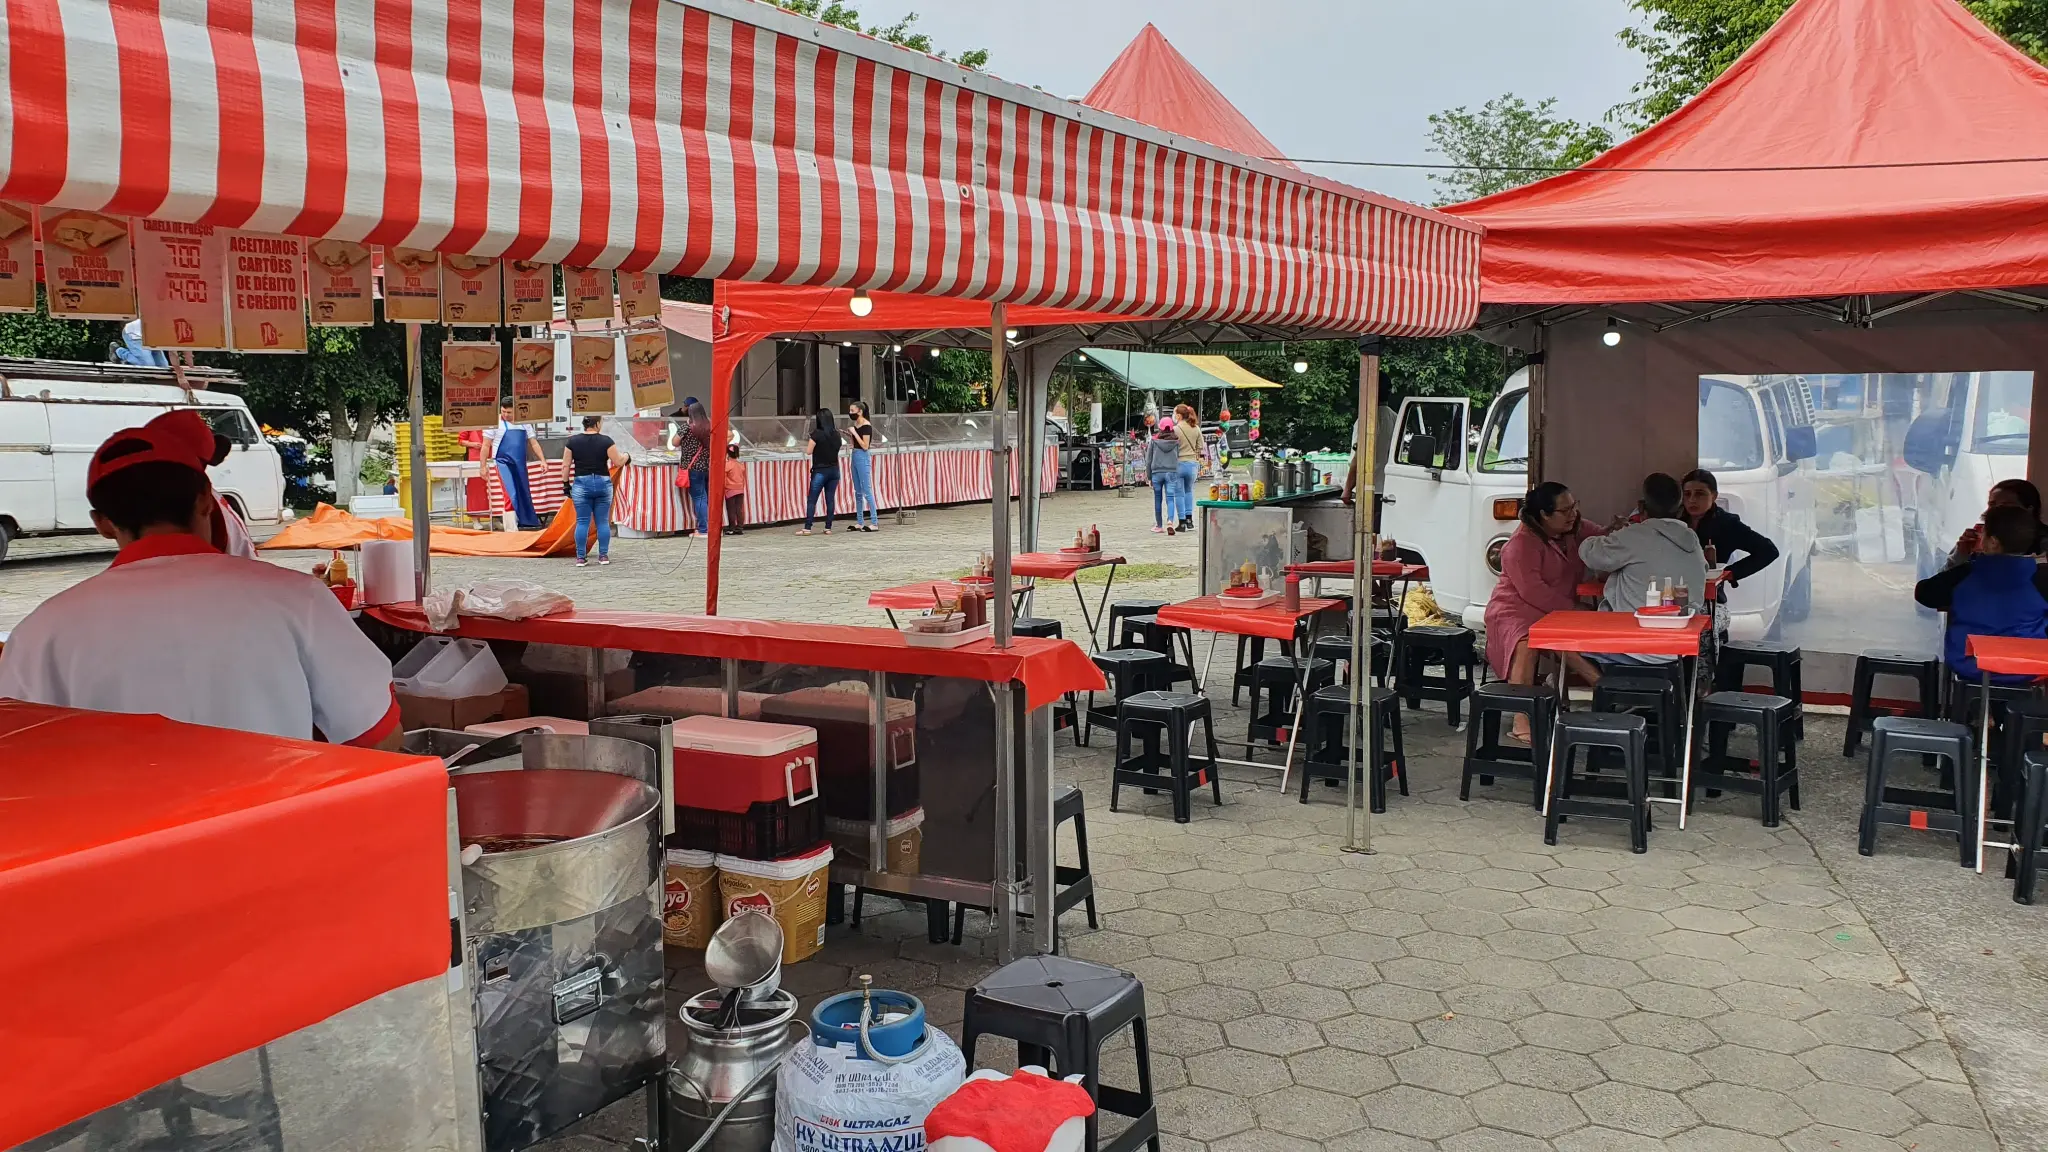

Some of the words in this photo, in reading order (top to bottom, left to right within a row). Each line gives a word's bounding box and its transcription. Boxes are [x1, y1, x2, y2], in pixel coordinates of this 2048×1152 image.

[230, 236, 298, 255] ACEITAMOS
[72, 255, 108, 268] FRANGO
[238, 255, 292, 274] CARTÕES
[58, 267, 80, 281] COM
[236, 275, 252, 290] DE
[253, 274, 296, 292] DÉBITO
[236, 294, 245, 309] E
[246, 293, 297, 311] CRÉDITO
[835, 1073, 846, 1083] HY
[819, 1114, 841, 1128] DISK
[843, 1114, 911, 1129] ULTRAGAZ
[796, 1122, 816, 1145] HY
